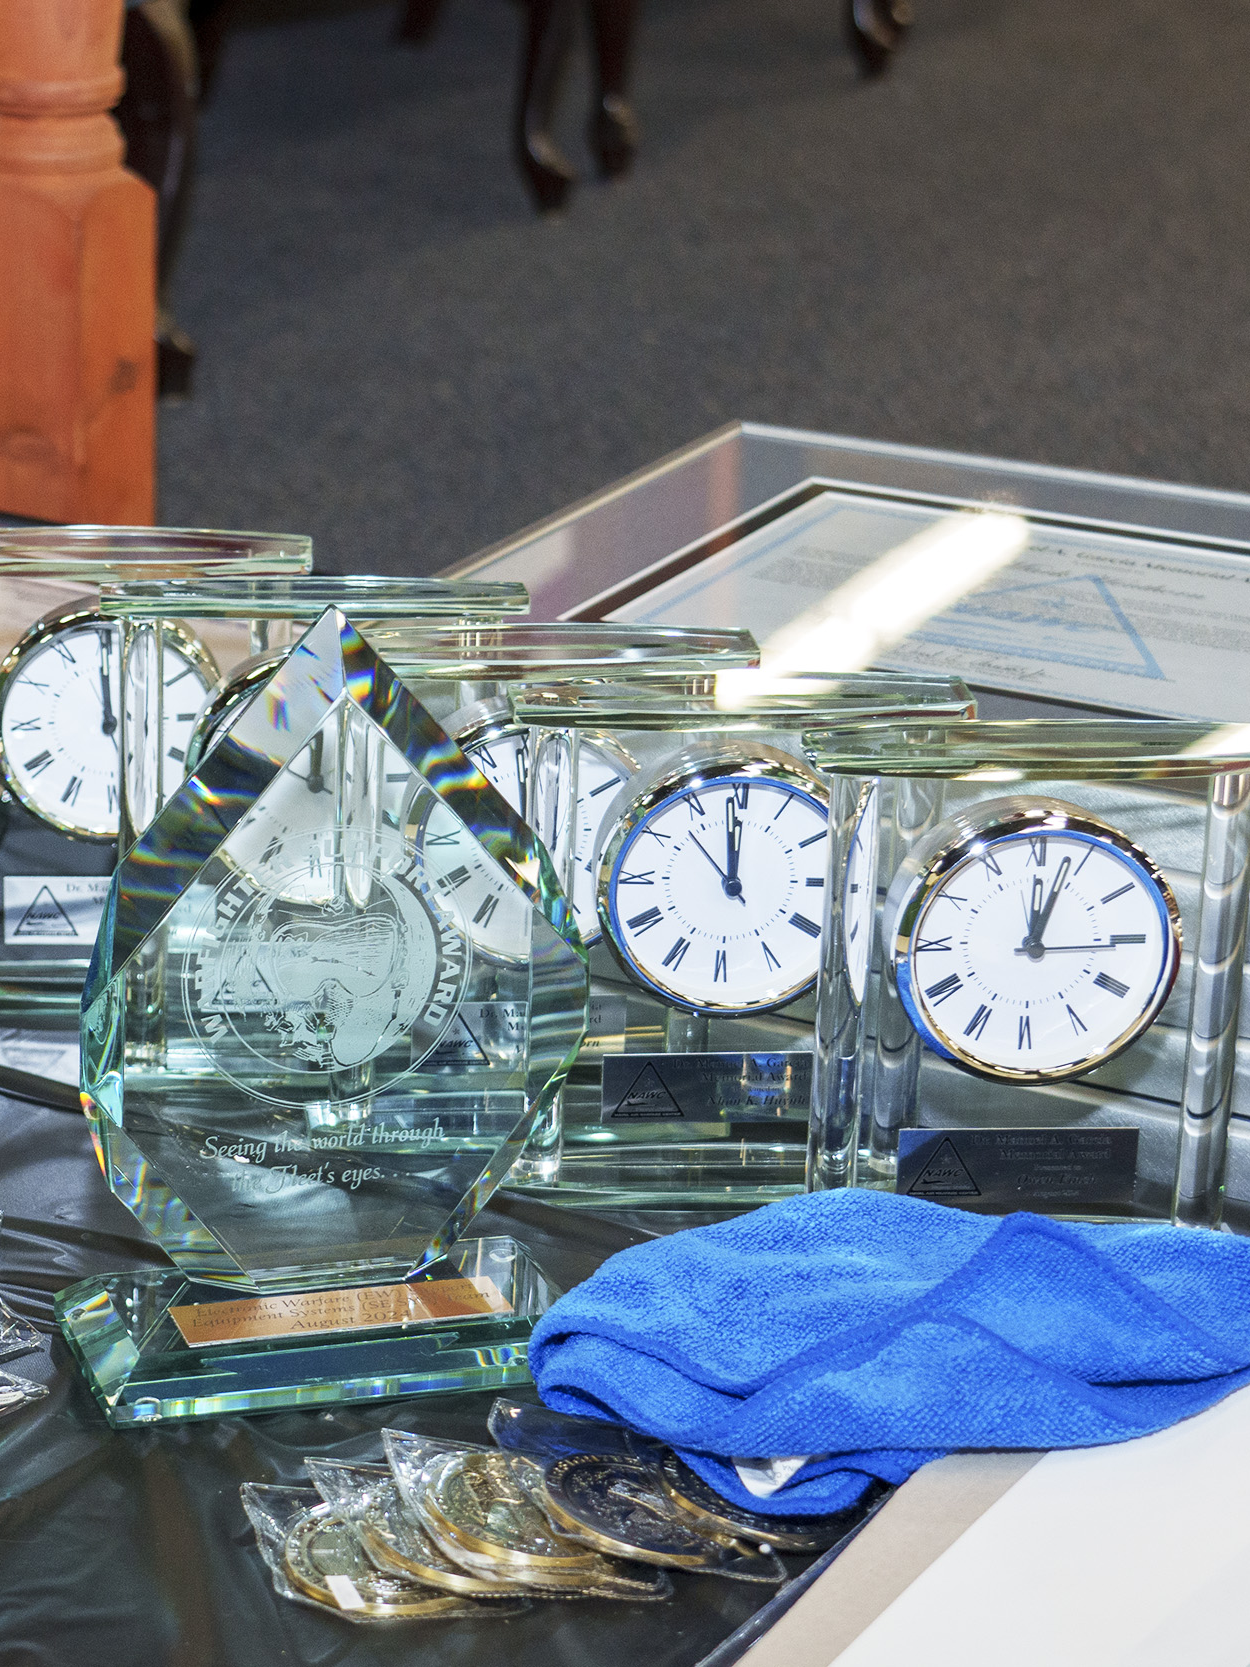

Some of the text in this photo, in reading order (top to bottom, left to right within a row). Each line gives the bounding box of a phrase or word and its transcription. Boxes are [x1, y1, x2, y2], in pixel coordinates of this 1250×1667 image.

[423, 909, 463, 1028] AWARD
[626, 1090, 668, 1100] NAWC
[199, 1116, 446, 1164] Seeing the world through
[264, 1161, 336, 1195] Fleet's
[923, 1168, 964, 1178] NAWC
[191, 1311, 283, 1329] Equipment
[288, 1302, 356, 1320] Systems
[195, 1300, 278, 1318] Electronic
[282, 1292, 352, 1310] Warfare
[356, 1288, 402, 1303] (EW)
[290, 1308, 412, 1331] August 2024
